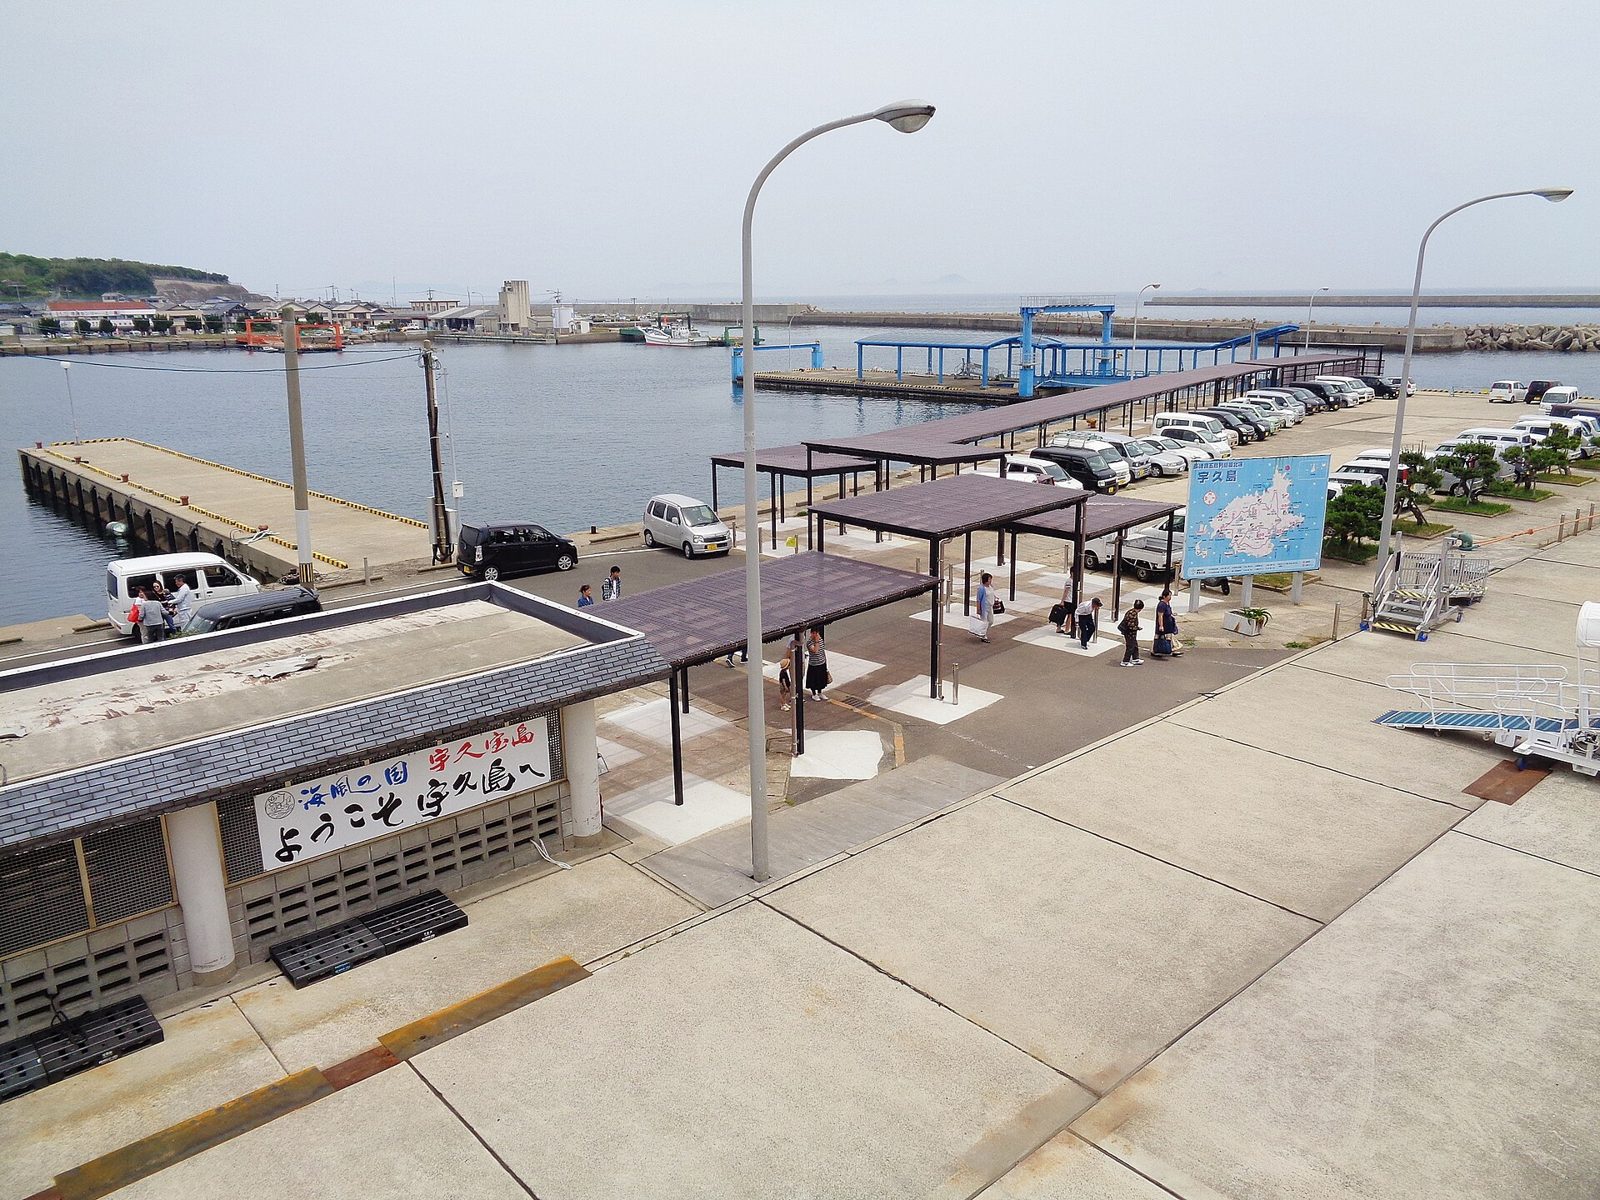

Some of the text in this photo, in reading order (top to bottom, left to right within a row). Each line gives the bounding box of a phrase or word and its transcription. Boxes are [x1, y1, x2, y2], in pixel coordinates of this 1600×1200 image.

[1197, 470, 1237, 484] 宇久島
[298, 723, 535, 810] 海風の国 宇久宝島
